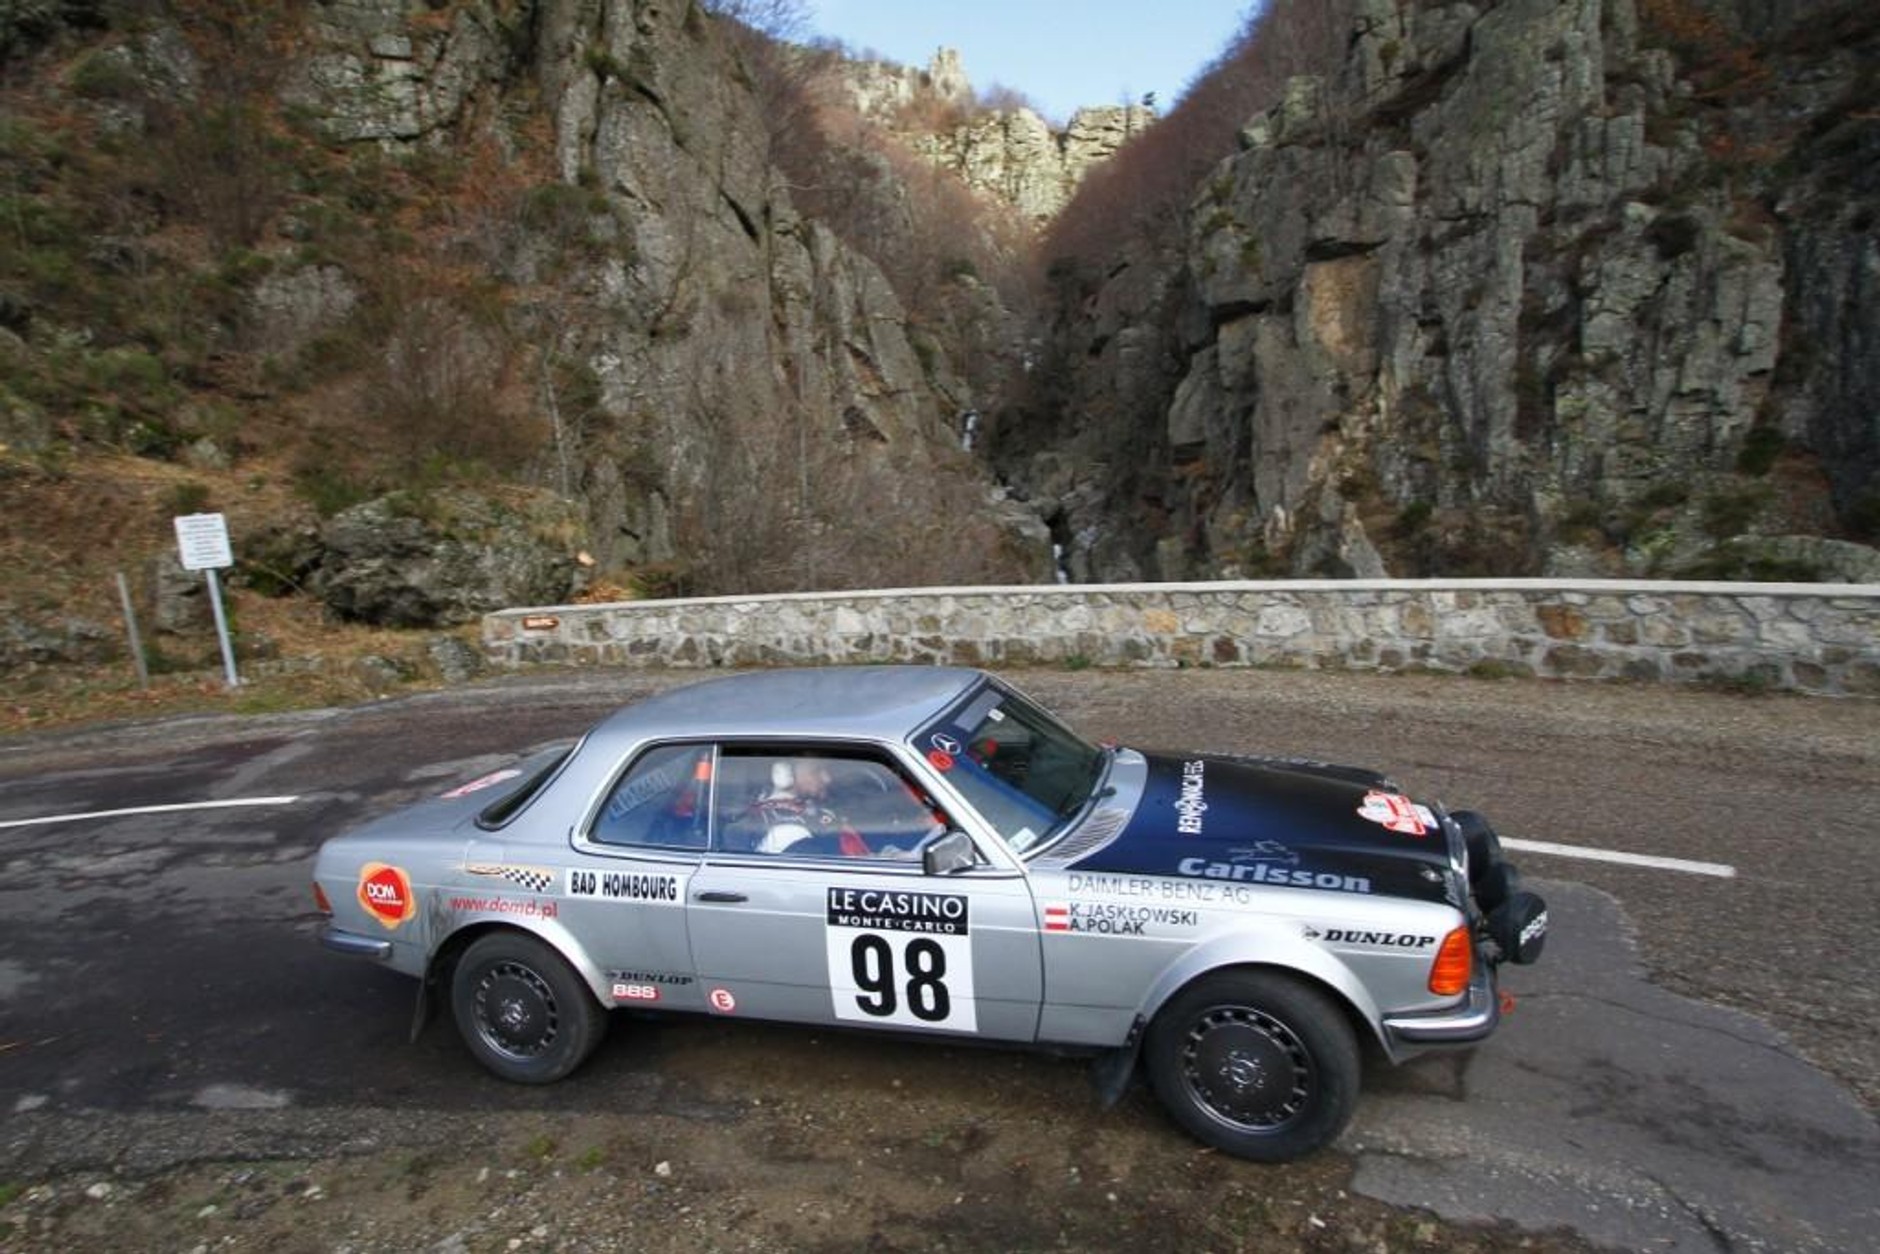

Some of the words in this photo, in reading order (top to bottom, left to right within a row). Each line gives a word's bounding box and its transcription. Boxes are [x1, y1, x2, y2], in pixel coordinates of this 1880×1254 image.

[571, 871, 596, 895] BAD
[603, 873, 677, 900] HOMBOURG
[1178, 857, 1371, 893] Carlsson
[830, 890, 855, 910] LE
[861, 892, 963, 918] CASINO
[1222, 886, 1250, 904] AG
[1069, 918, 1146, 935] A.POLAK
[1324, 929, 1436, 948] DUNLOP
[620, 971, 693, 985] DUNLOP
[851, 933, 951, 1022] 98
